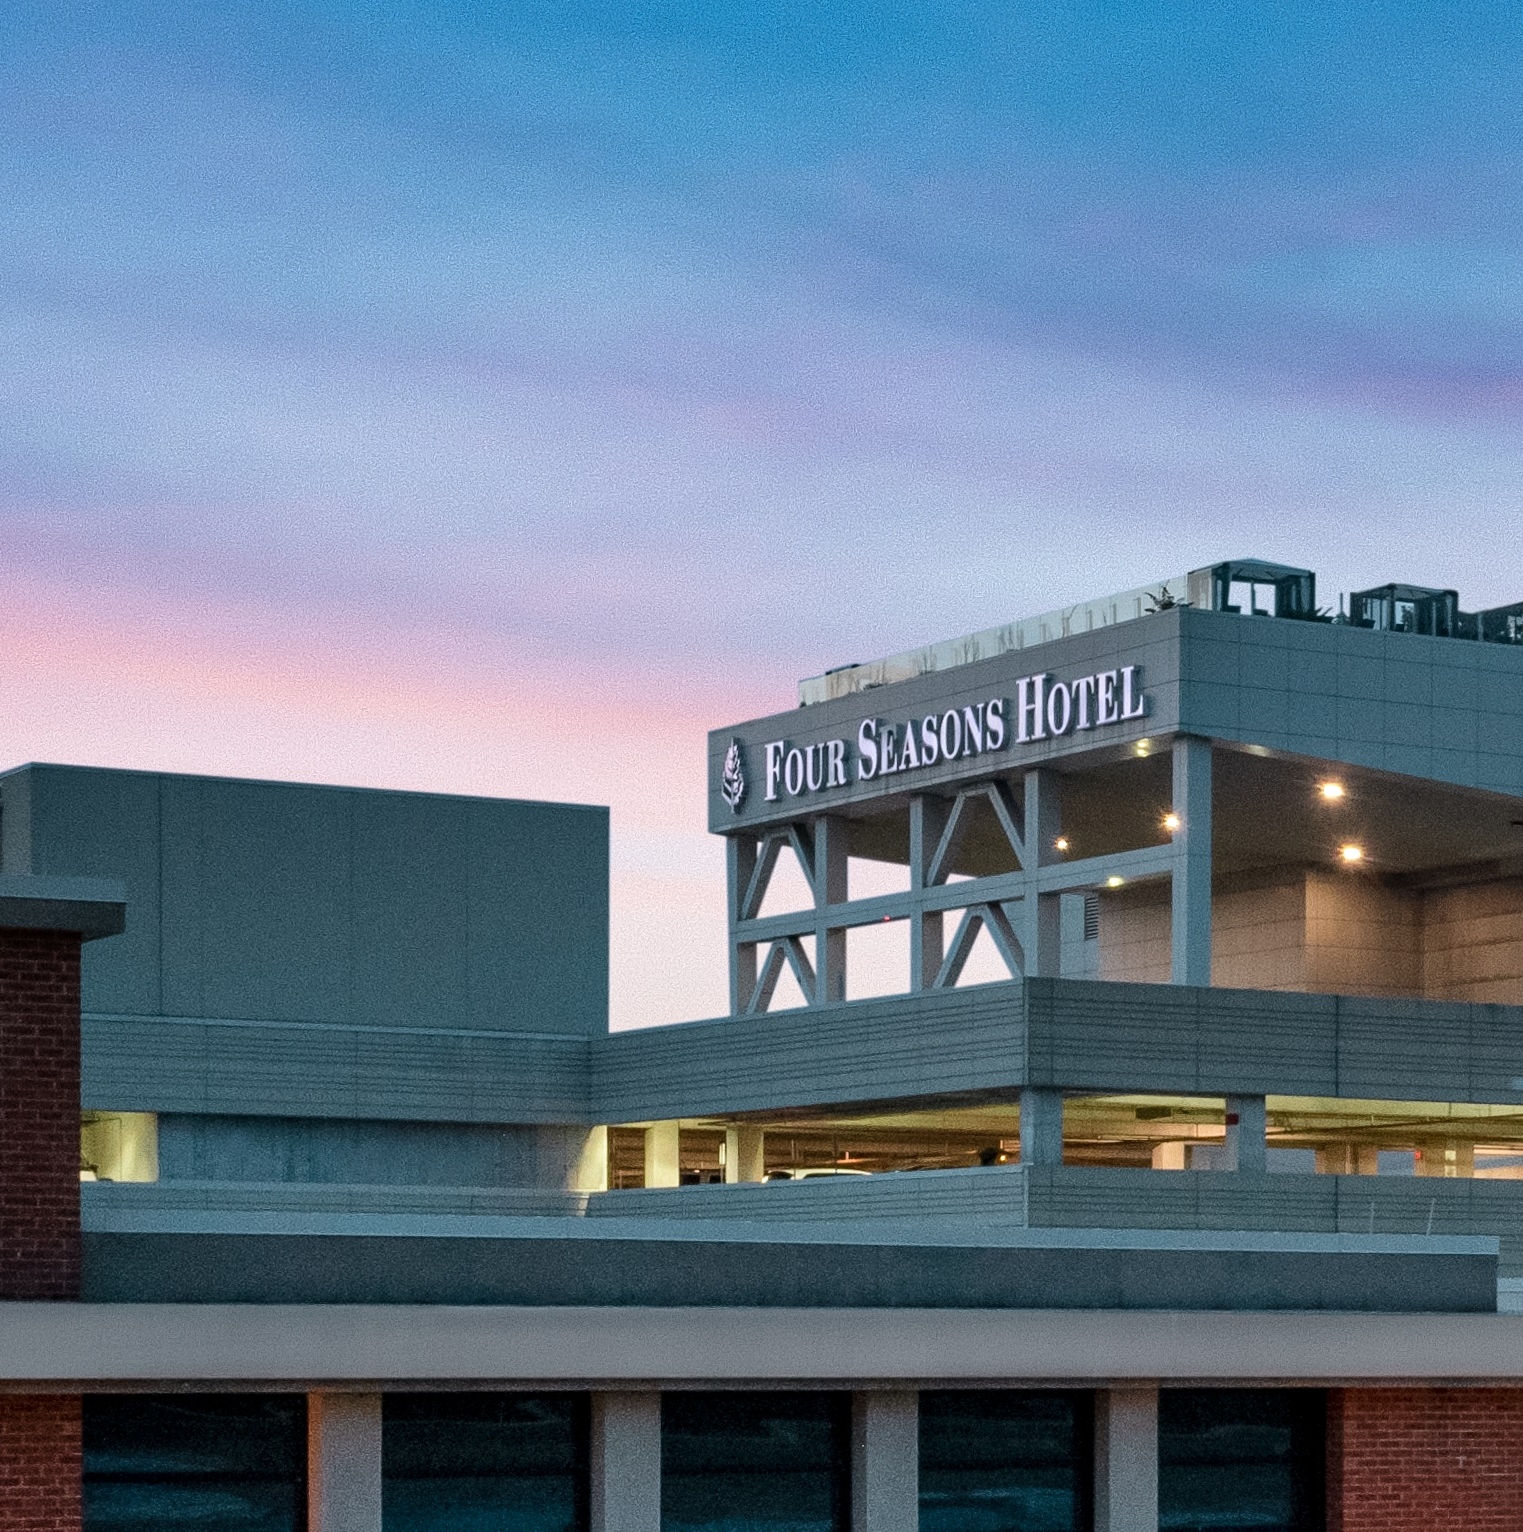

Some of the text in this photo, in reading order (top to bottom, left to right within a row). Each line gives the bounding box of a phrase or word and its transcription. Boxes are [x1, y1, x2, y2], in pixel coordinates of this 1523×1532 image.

[763, 665, 1145, 802] FOUR SEASONS HOTEL
